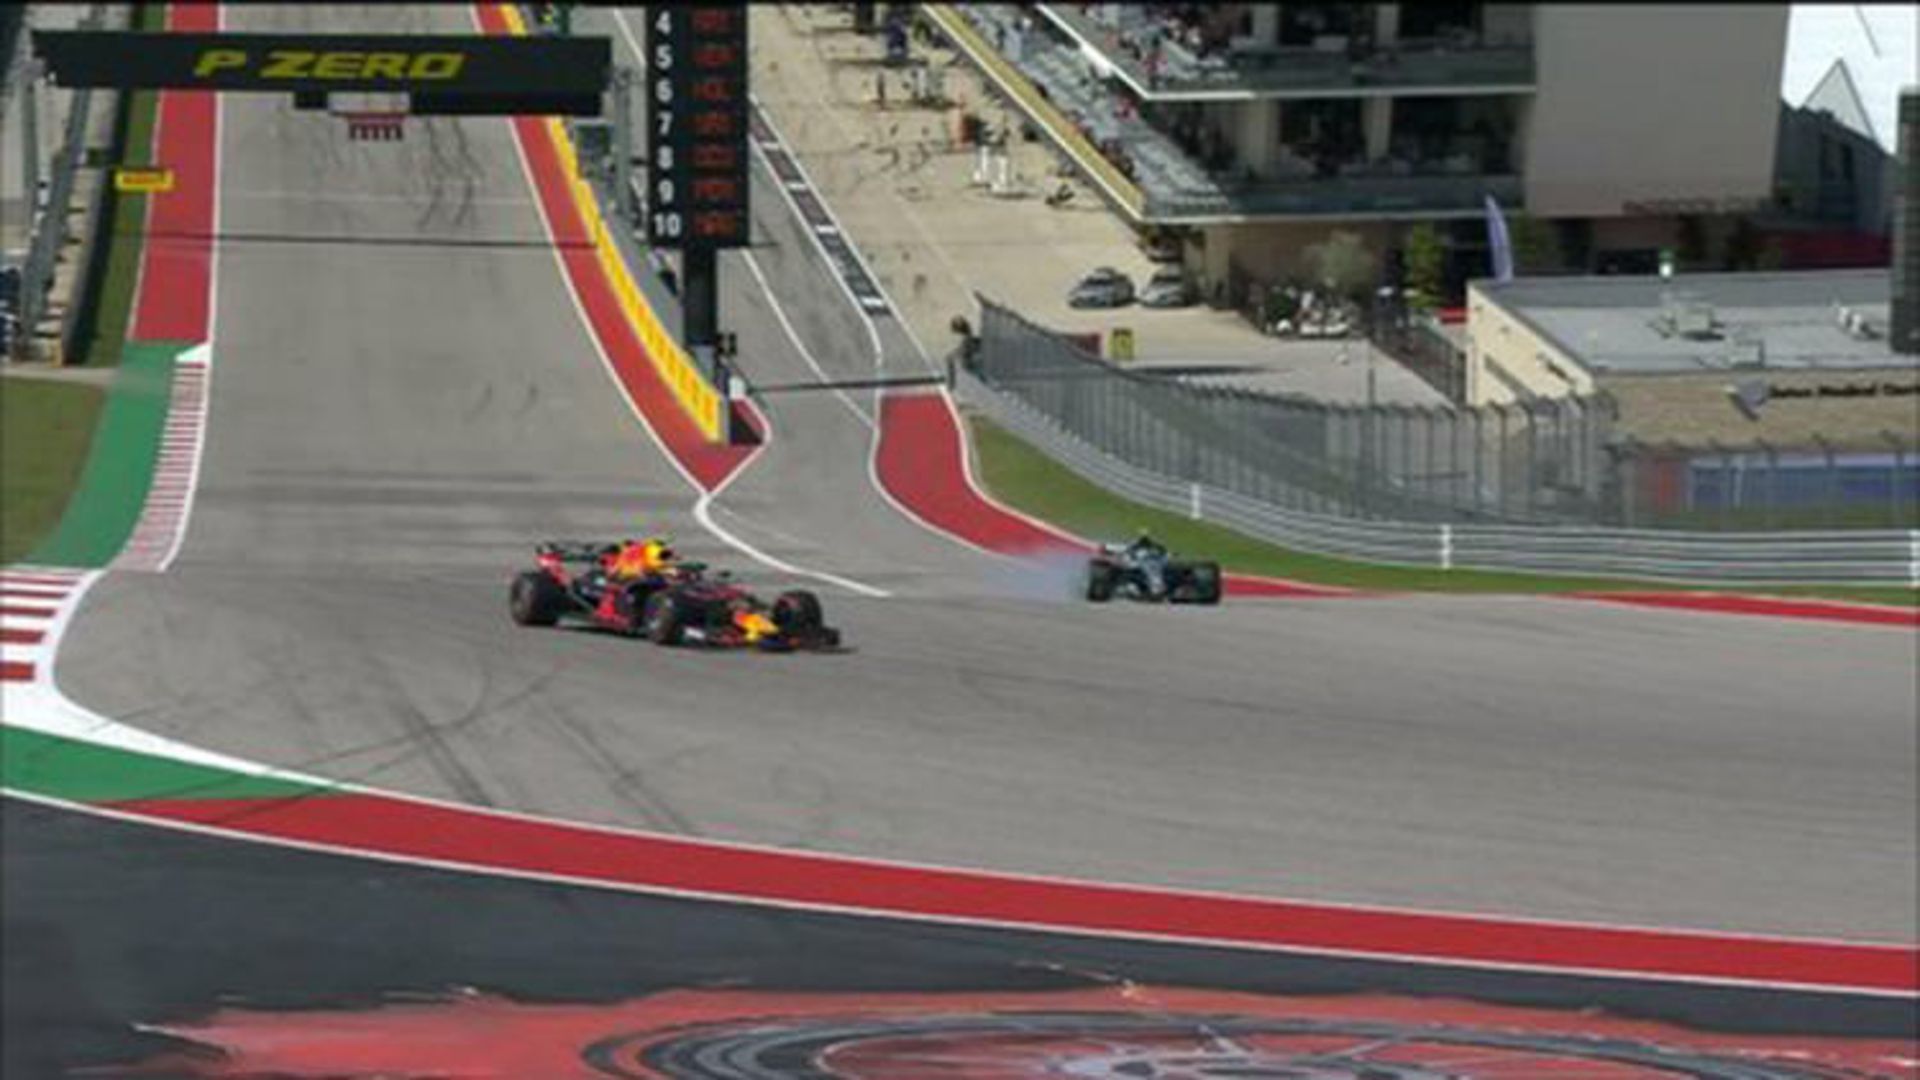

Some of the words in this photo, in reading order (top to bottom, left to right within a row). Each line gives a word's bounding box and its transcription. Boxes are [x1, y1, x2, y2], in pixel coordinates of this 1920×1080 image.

[656, 11, 672, 34] 4
[194, 48, 247, 77] P
[255, 49, 467, 81] ZERO
[656, 45, 673, 69] 5
[656, 79, 673, 102] 6
[657, 112, 673, 135] 7
[657, 146, 674, 170] 8
[658, 180, 674, 204] 9
[653, 213, 682, 237] 10
